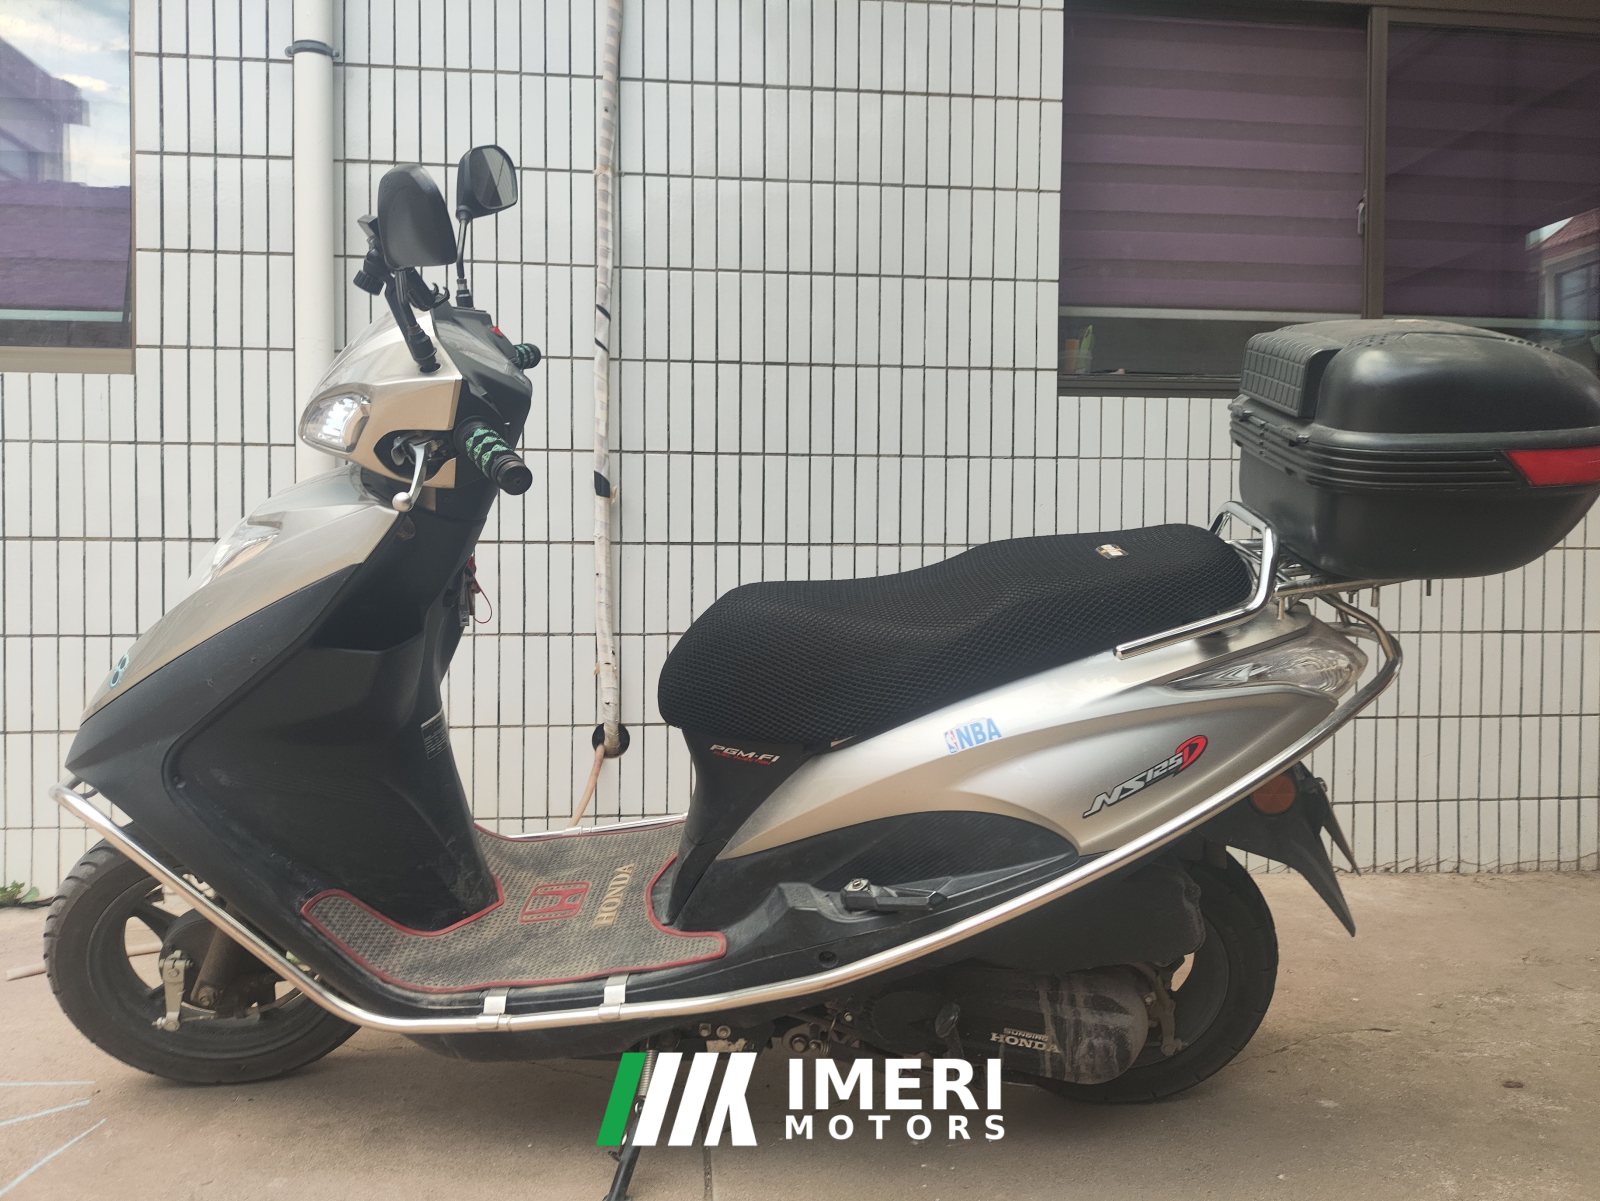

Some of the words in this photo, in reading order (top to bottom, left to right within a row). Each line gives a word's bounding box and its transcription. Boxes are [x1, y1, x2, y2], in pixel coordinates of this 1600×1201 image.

[955, 718, 1002, 750] NBA
[591, 863, 635, 929] HONDA
[990, 1032, 1061, 1054] HONDA
